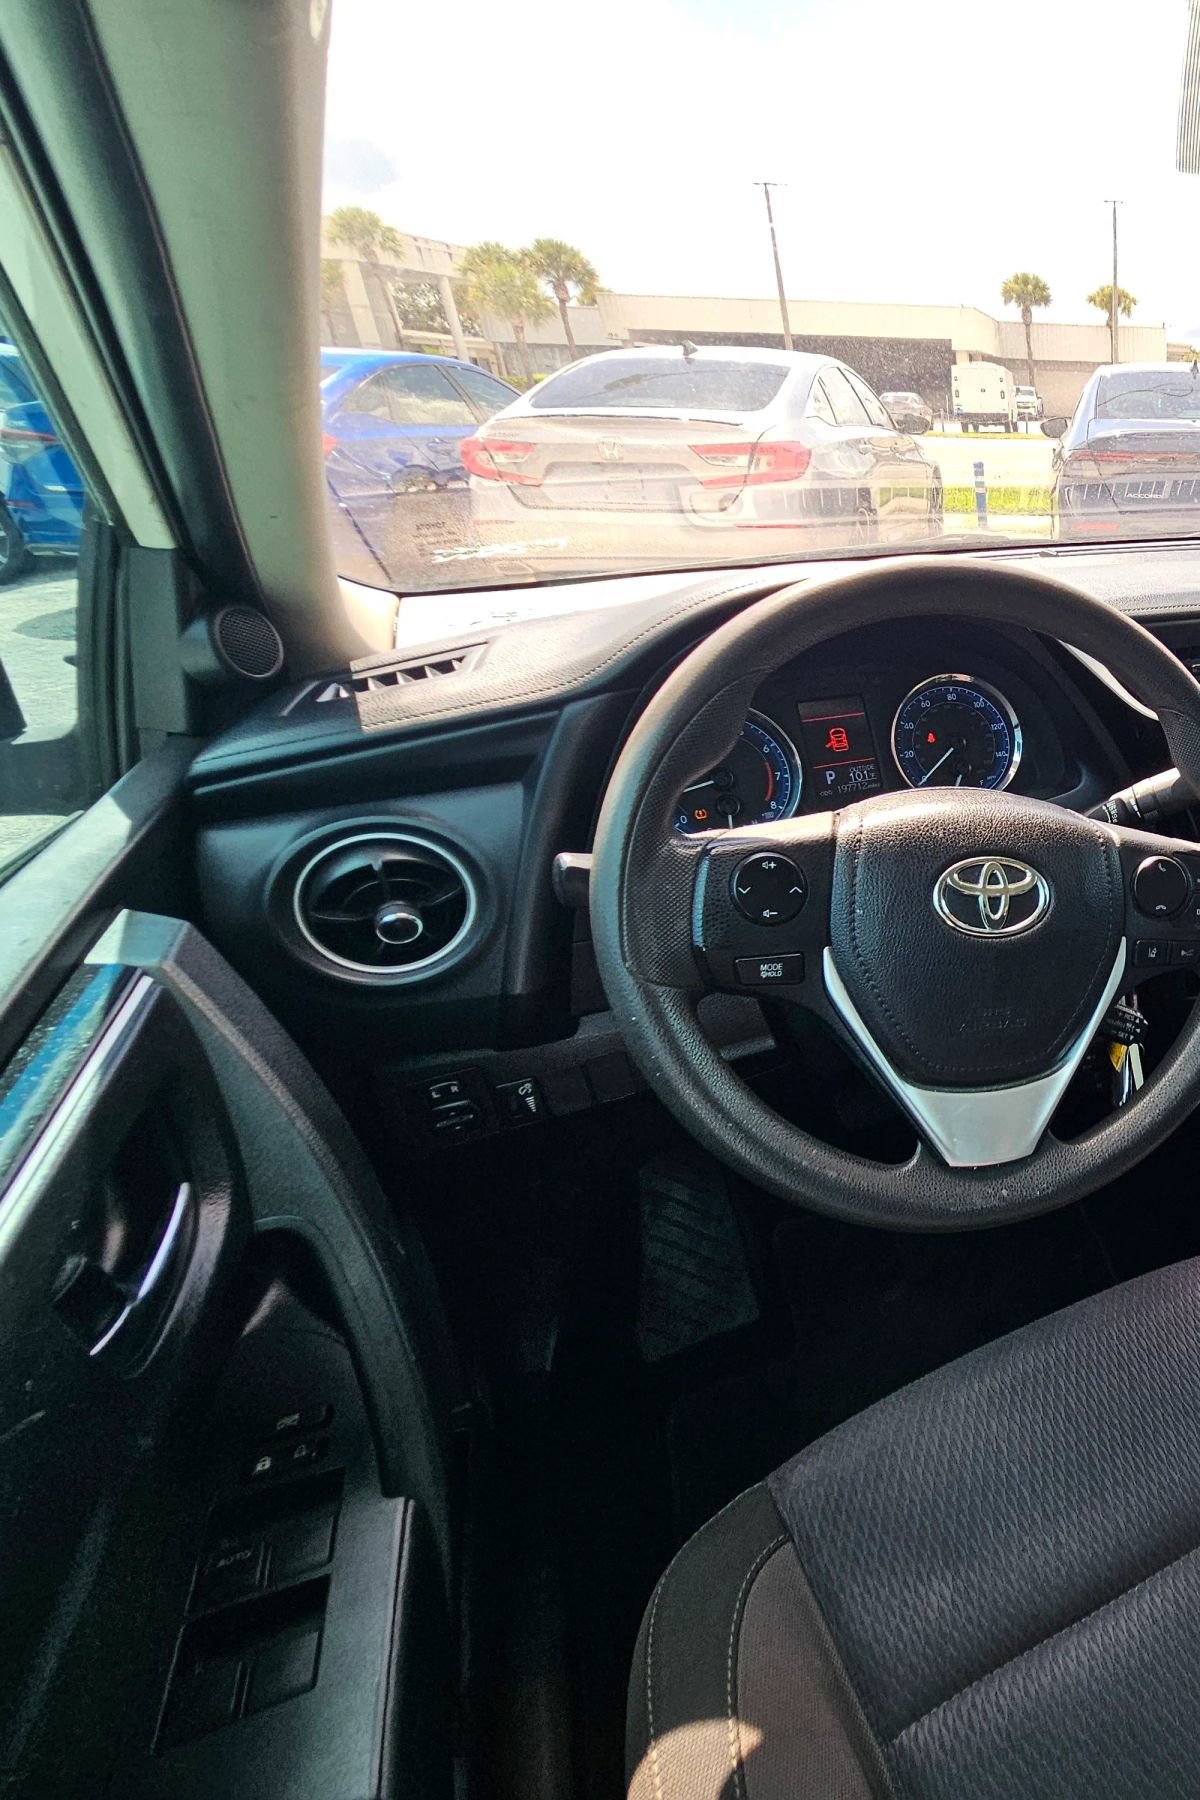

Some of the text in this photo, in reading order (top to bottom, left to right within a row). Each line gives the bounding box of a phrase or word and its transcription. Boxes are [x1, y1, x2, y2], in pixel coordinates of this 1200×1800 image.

[946, 693, 957, 701] 80
[921, 699, 931, 708] 60
[973, 700, 985, 708] 100
[763, 744, 770, 753] 6
[995, 750, 1006, 758] 140
[774, 772, 781, 781] 7
[825, 770, 836, 785] P
[770, 801, 777, 809] 8
[680, 815, 687, 824] 0
[760, 963, 783, 971] MODE
[450, 1085, 460, 1093] R
